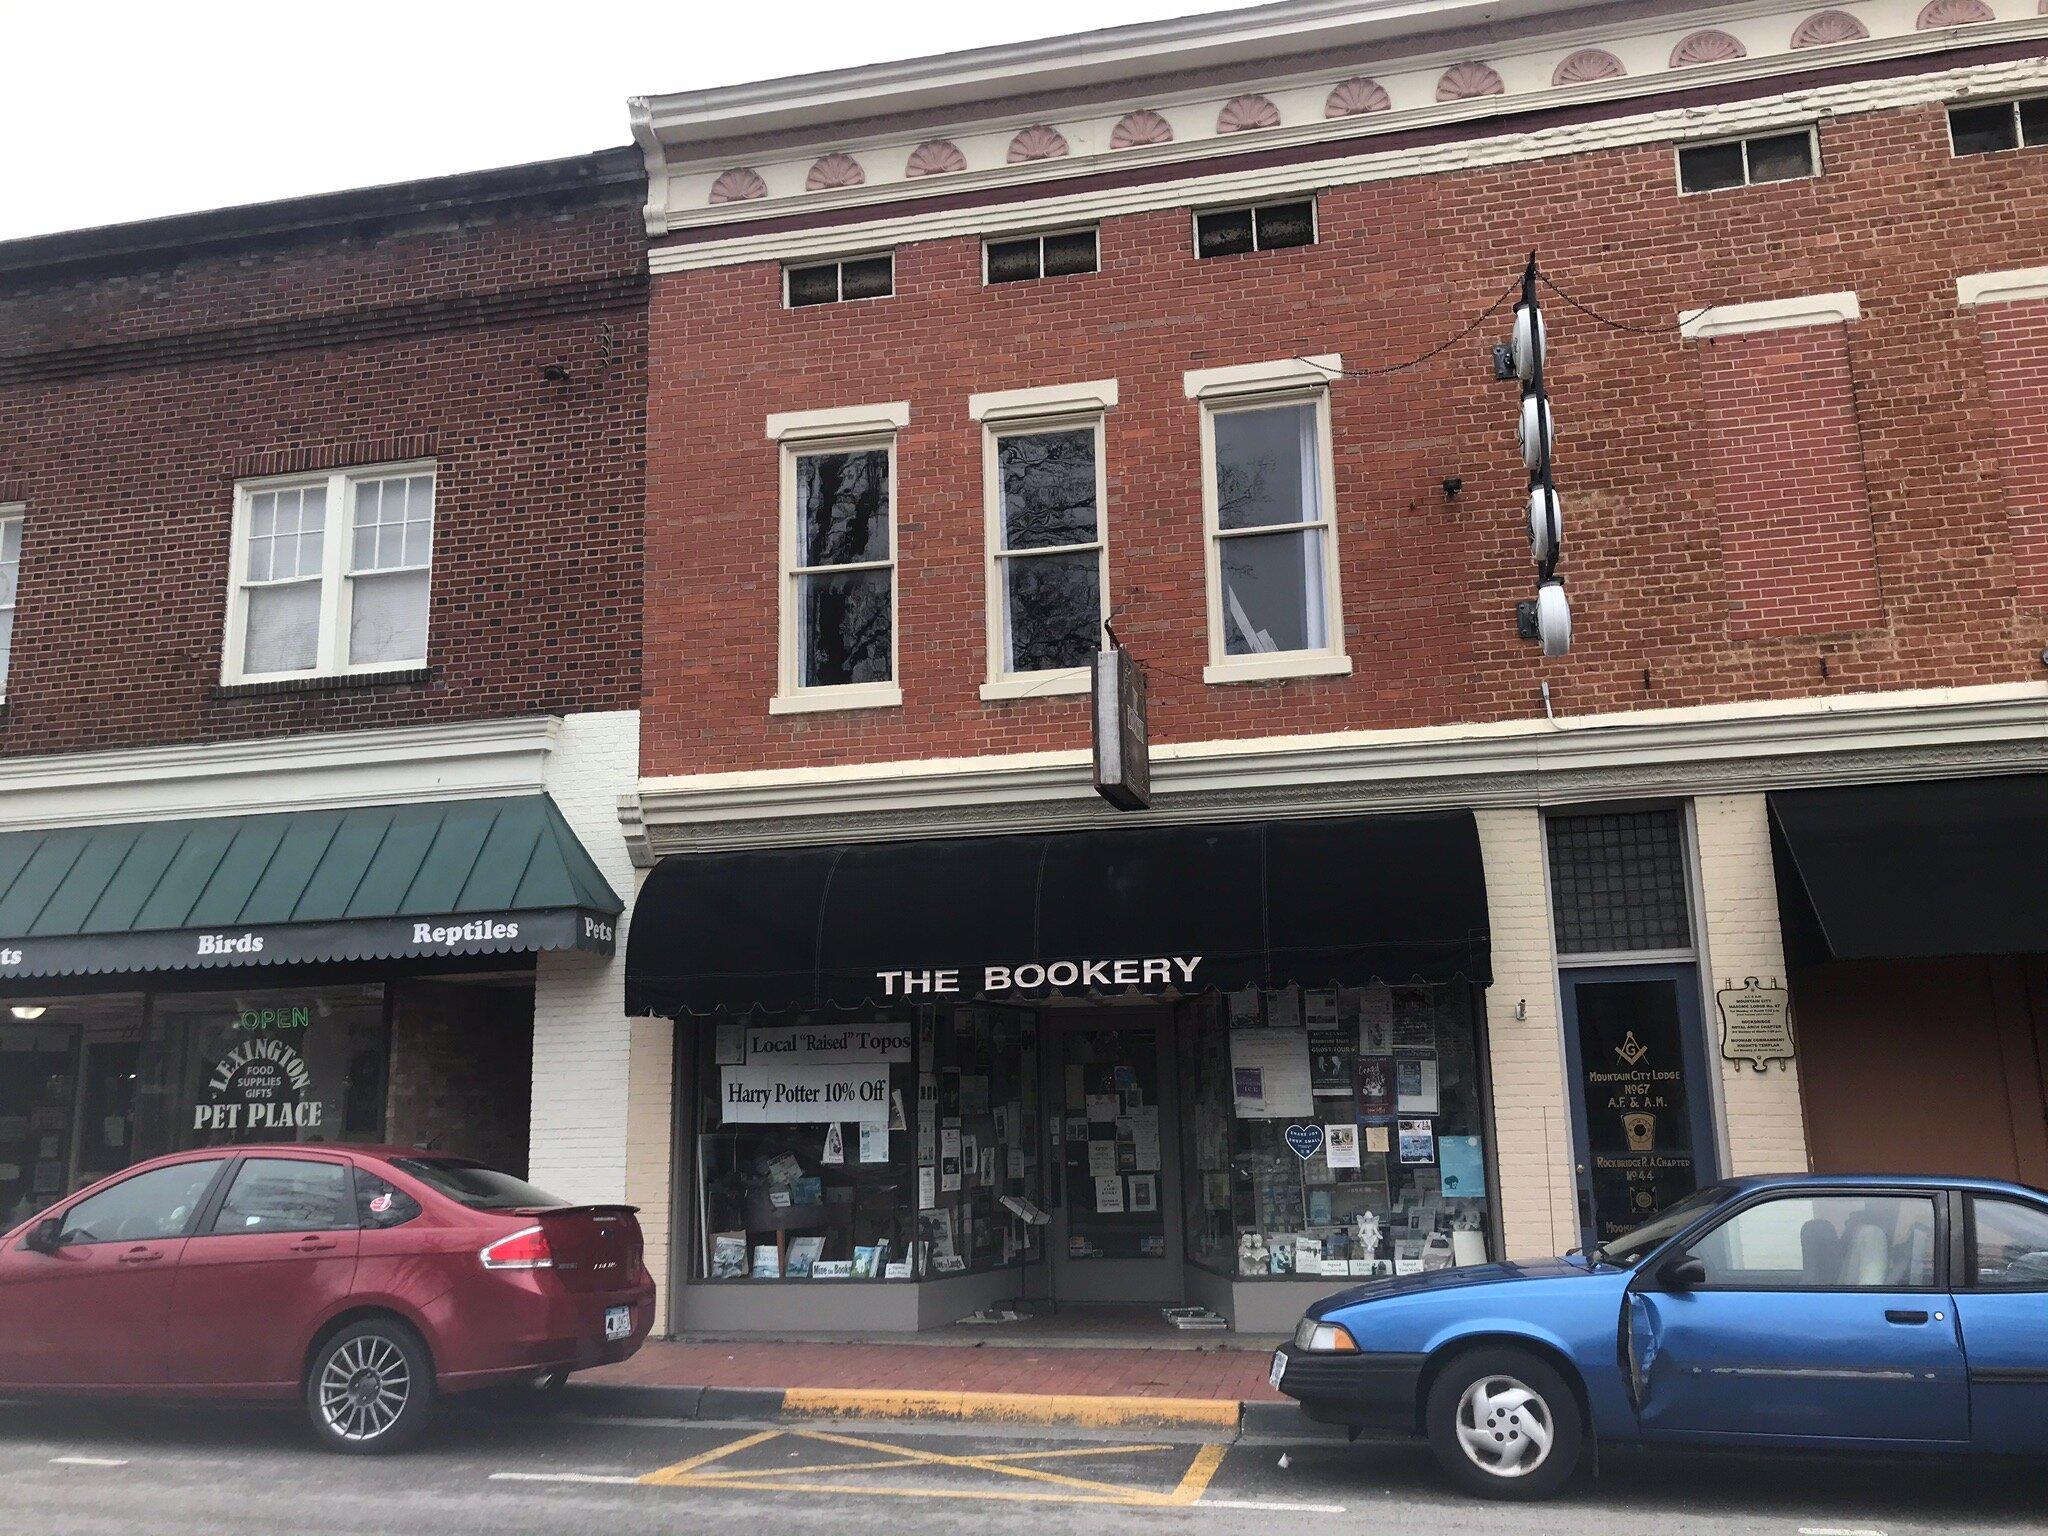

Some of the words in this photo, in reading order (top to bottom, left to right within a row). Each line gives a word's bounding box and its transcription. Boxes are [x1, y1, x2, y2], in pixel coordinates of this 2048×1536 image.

[412, 920, 520, 946] Reptiles
[584, 916, 612, 942] Pets
[197, 933, 264, 955] Birds
[0, 948, 22, 965] ts
[876, 969, 960, 995] THE
[984, 956, 1202, 991] BOOKERY
[240, 1007, 309, 1030] OPEN
[752, 1034, 797, 1053] Local
[857, 1032, 910, 1053] Topos
[1625, 1043, 1636, 1056] G
[209, 1038, 311, 1092] LEXINGTON
[247, 1066, 274, 1076] FOOD
[1590, 1071, 1631, 1082] MOUNTAIN
[1631, 1070, 1651, 1081] CITY
[1652, 1069, 1680, 1080] LODGE
[237, 1077, 281, 1087] SUPPLIES
[245, 1088, 272, 1099] GIFTS
[728, 1083, 771, 1109] Harry
[775, 1083, 820, 1103] Potter
[824, 1082, 855, 1102] 10%
[859, 1079, 886, 1100] Off
[1608, 1097, 1626, 1108] A.F.
[1630, 1097, 1640, 1108] &
[1644, 1096, 1668, 1107] A.M.
[193, 1103, 241, 1130] PET
[247, 1102, 322, 1128] PLACE
[1597, 1157, 1642, 1168] ROCKBRIDGE
